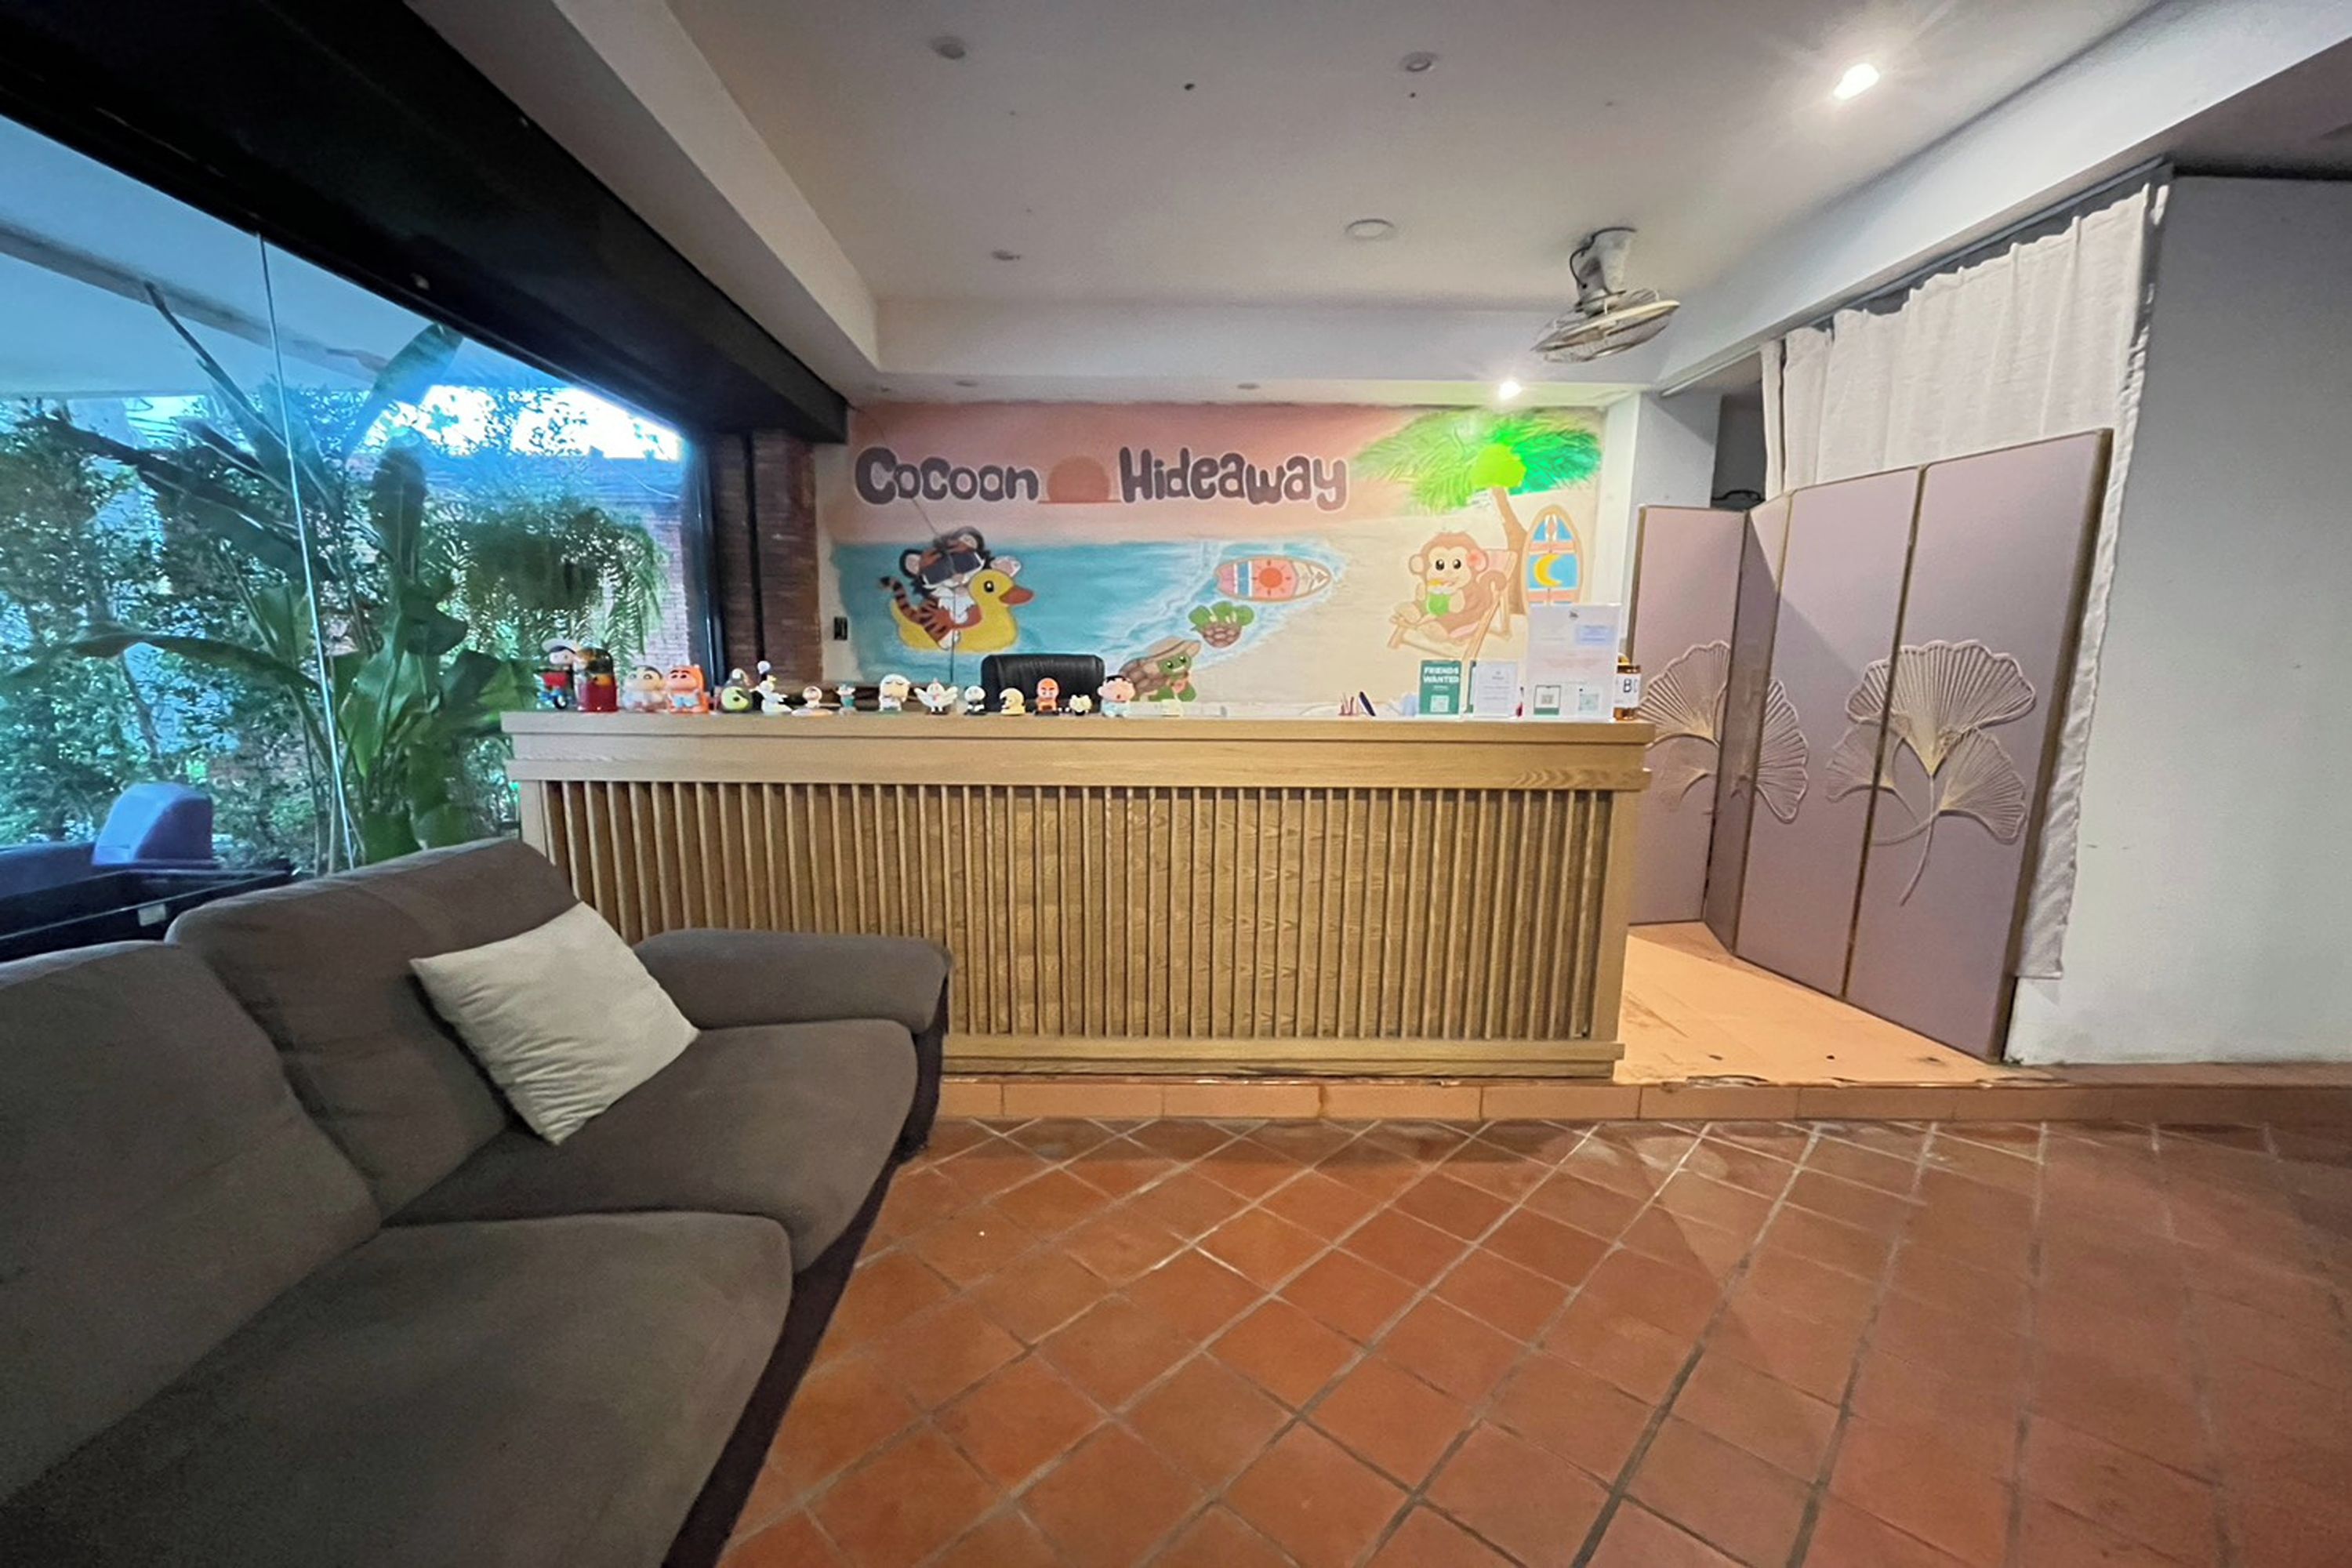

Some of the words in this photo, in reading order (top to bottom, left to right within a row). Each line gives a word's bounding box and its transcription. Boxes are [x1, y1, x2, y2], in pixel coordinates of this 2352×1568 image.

[1120, 446, 1348, 511] Hideaway
[1424, 666, 1460, 675] FRIENDS
[1422, 675, 1460, 684] WANTED
